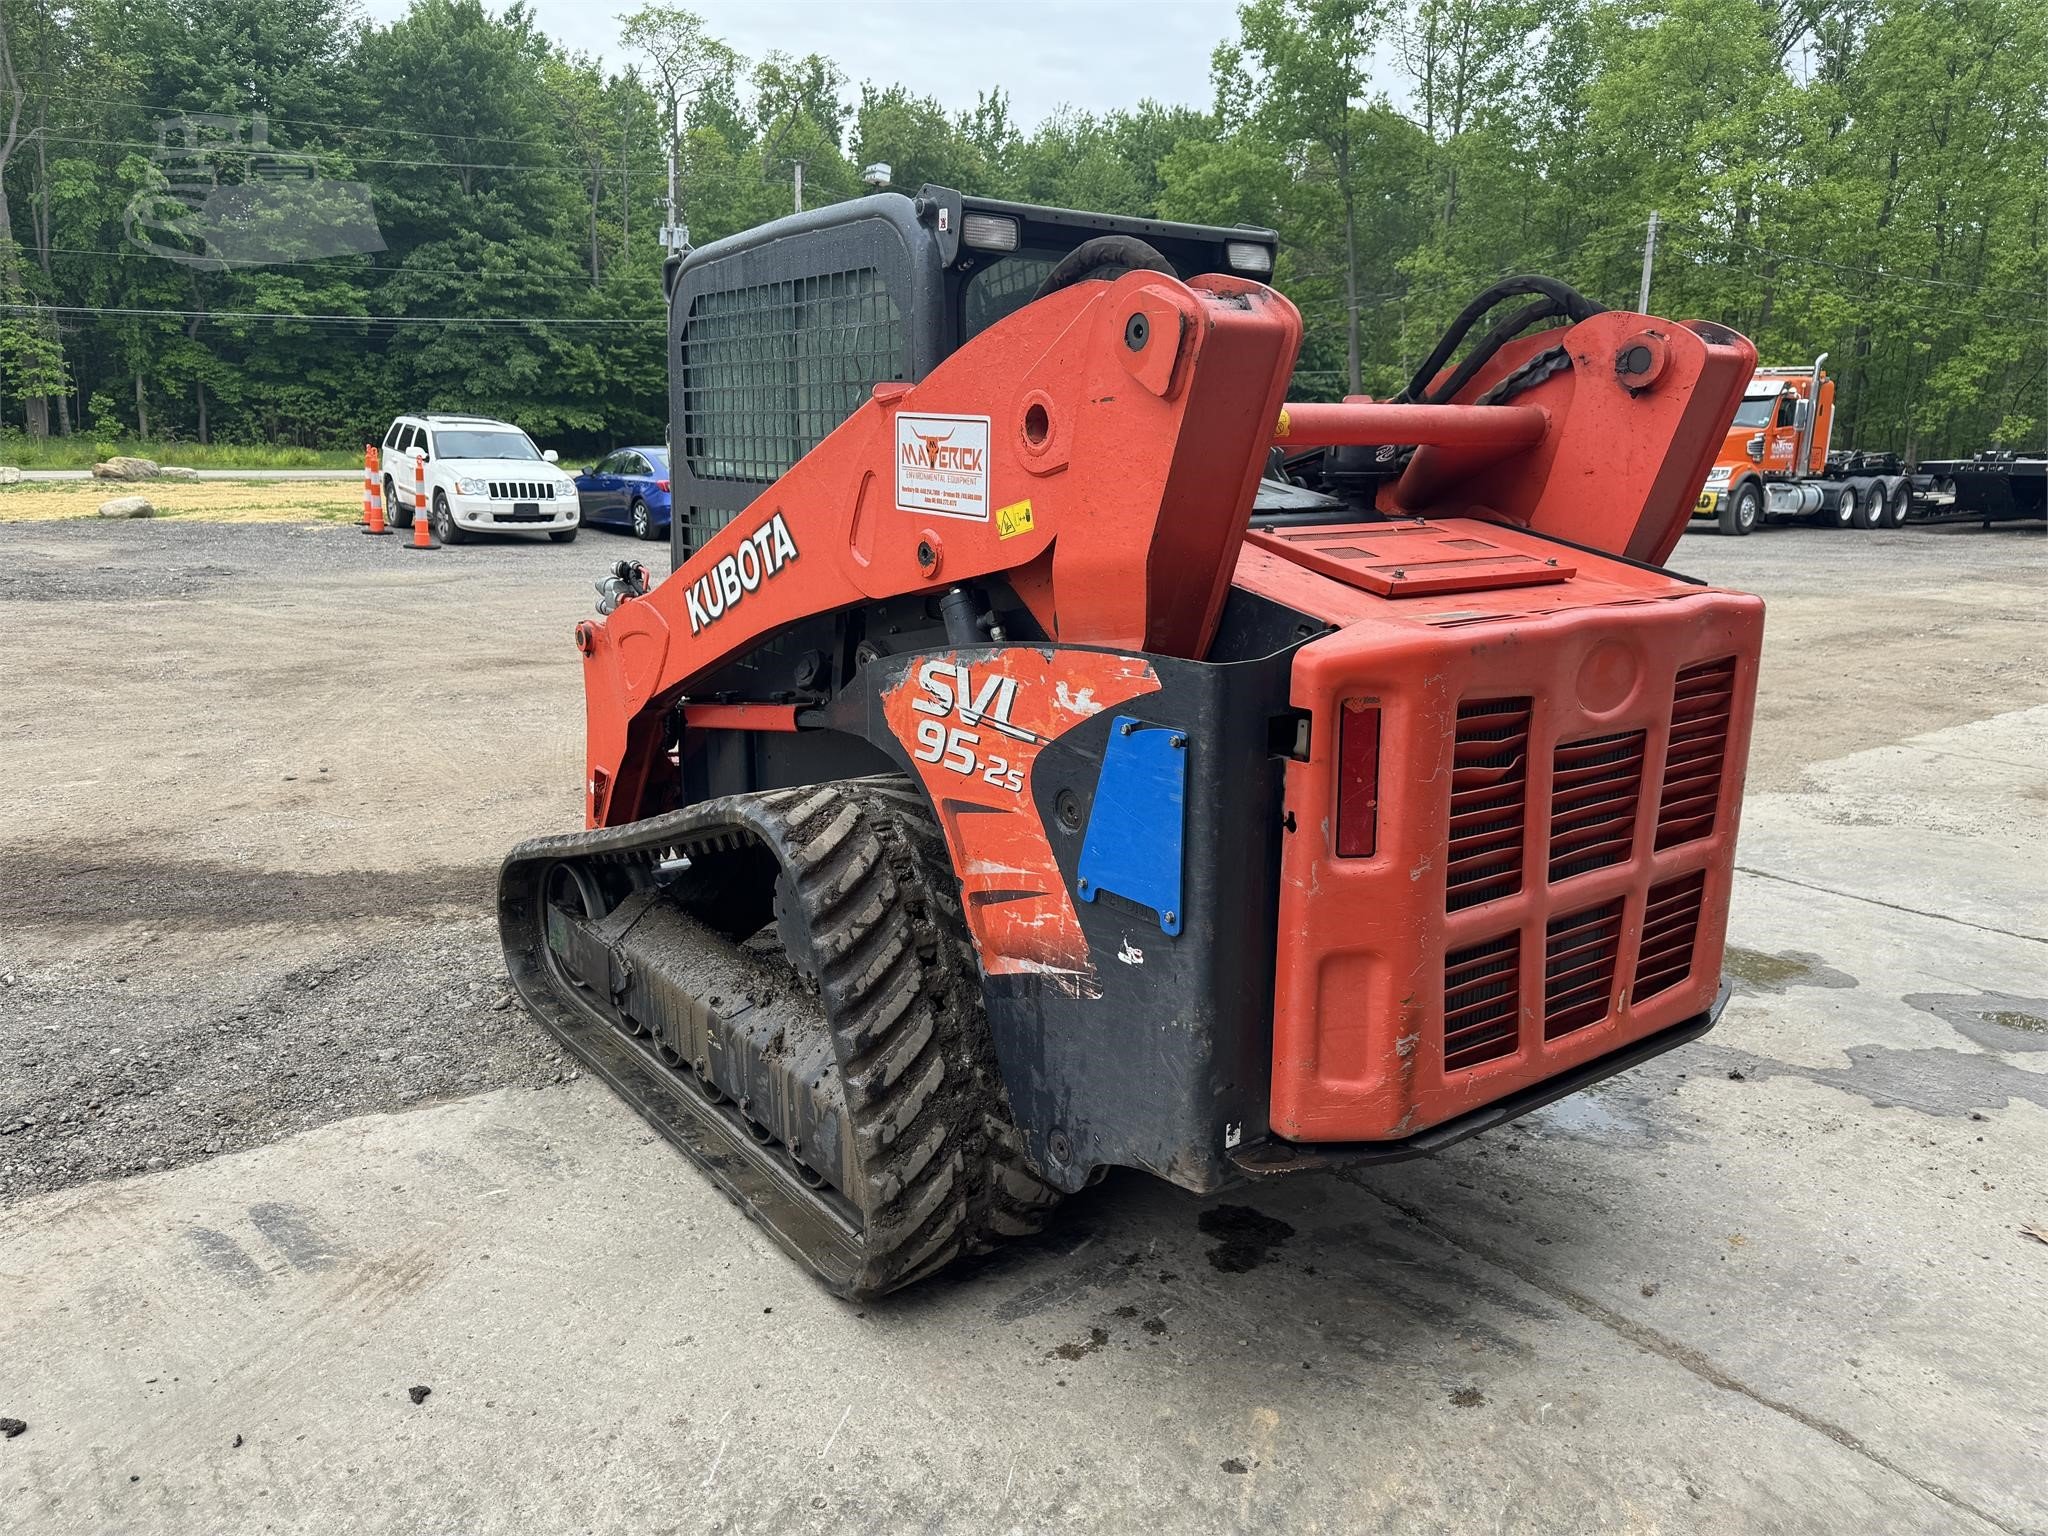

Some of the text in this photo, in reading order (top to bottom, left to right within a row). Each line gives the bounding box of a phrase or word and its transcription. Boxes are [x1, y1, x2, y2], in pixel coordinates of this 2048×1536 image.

[902, 442, 982, 471] MAVERICK
[906, 470, 977, 486] ENVIRONMENTAL EQUIPMENT
[684, 512, 798, 635] KUBOTA
[911, 660, 1037, 743] SVL
